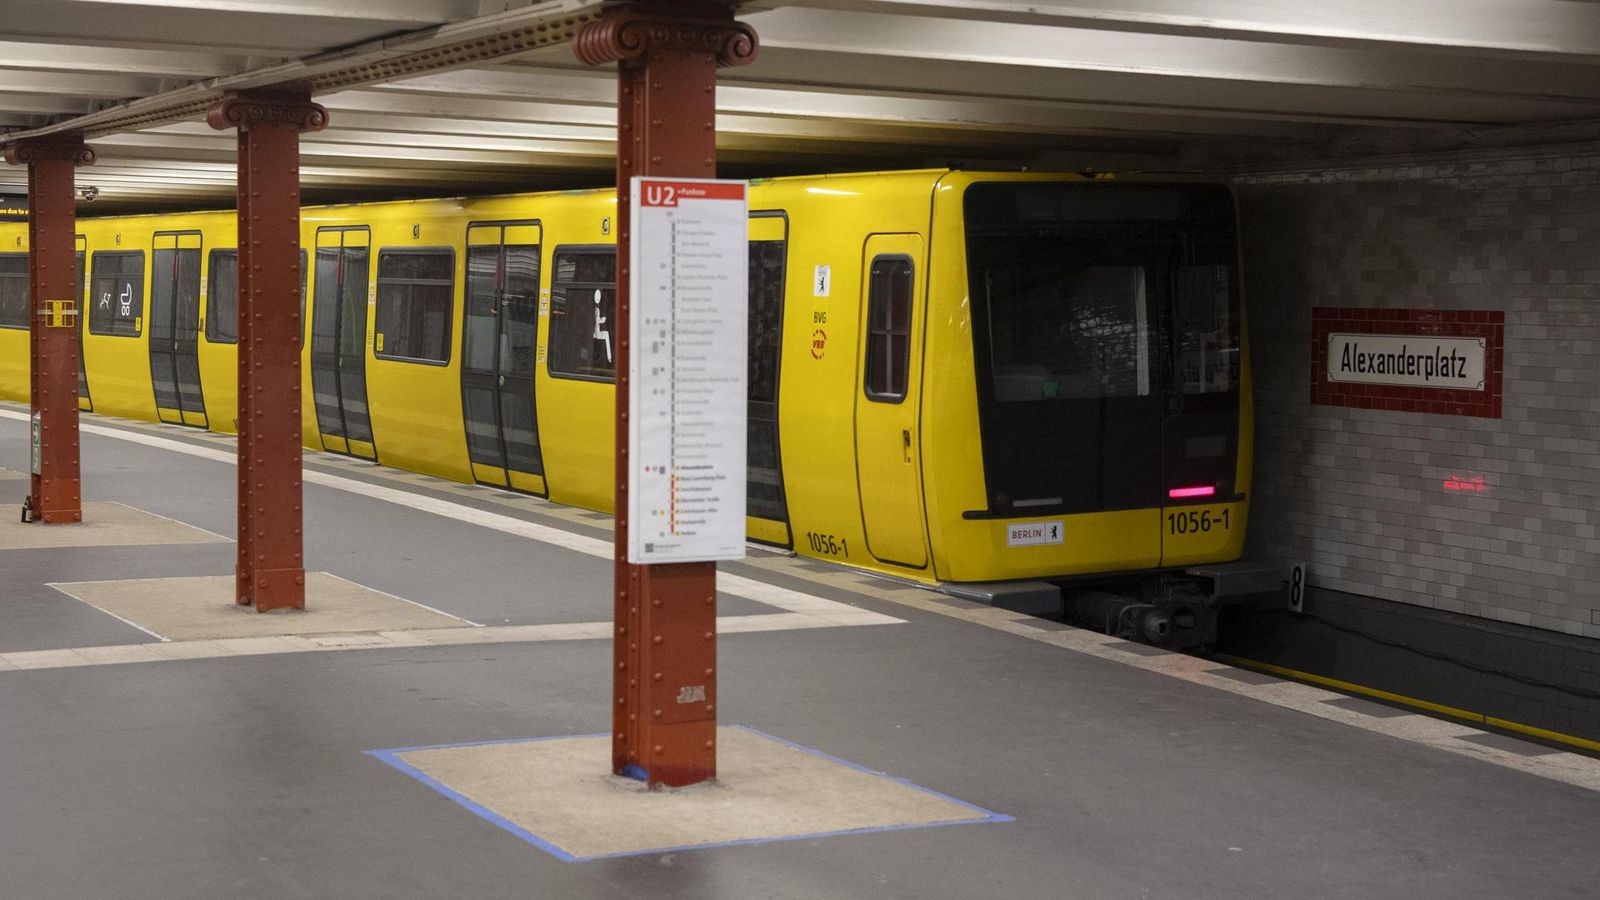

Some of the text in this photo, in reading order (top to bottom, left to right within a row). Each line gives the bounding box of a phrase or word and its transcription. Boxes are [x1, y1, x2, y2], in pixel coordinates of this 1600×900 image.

[647, 186, 676, 206] U2
[814, 311, 826, 323] BVG
[1341, 342, 1467, 381] Alexanderplatz
[1011, 529, 1042, 540] BERLIN
[1168, 508, 1230, 535] 1056-1
[807, 531, 849, 558] 1056-1
[1291, 566, 1303, 606] 8
